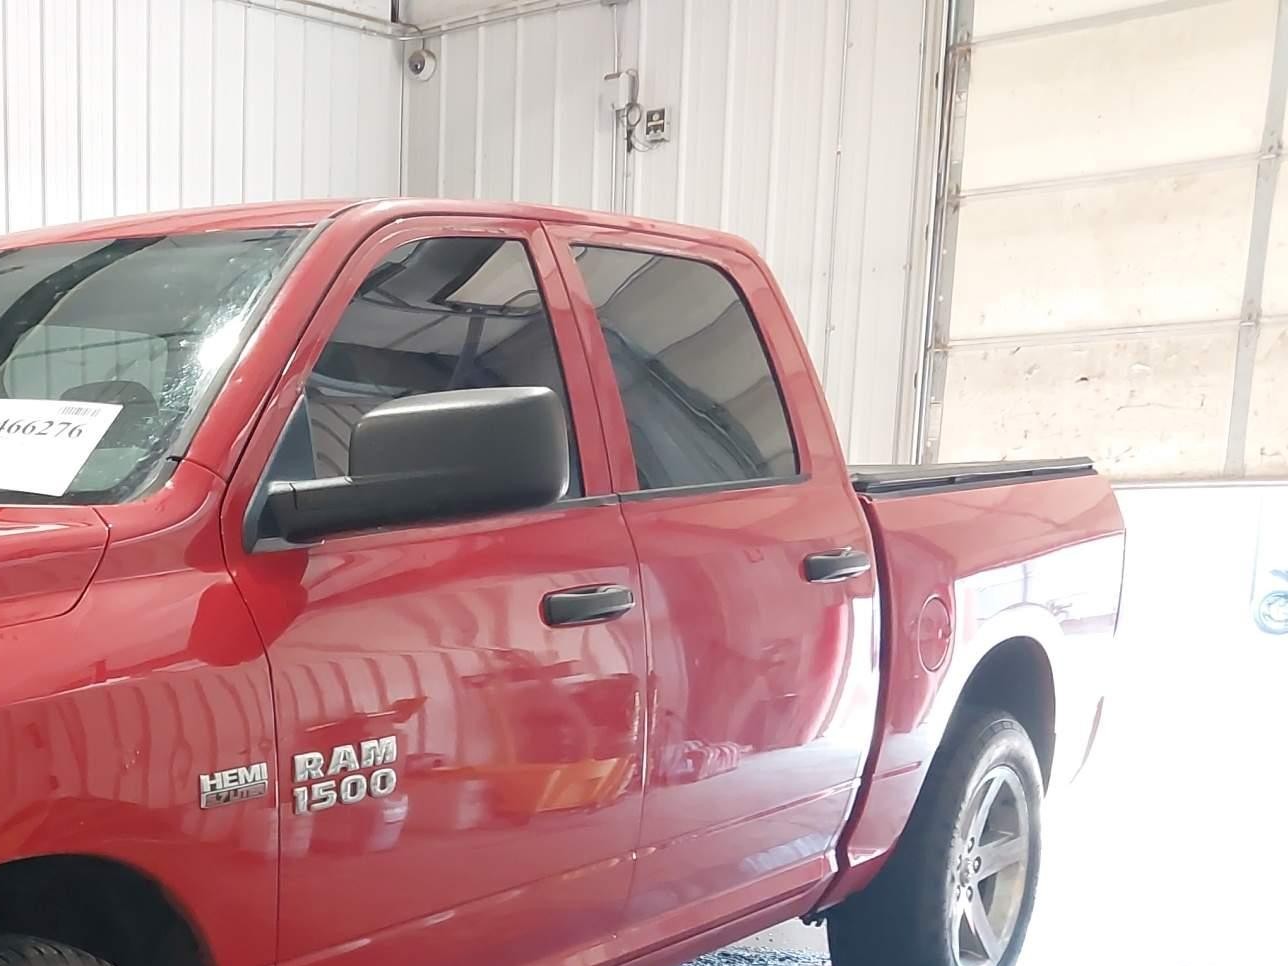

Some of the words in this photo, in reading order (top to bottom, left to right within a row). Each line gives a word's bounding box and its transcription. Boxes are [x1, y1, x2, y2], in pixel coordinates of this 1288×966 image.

[199, 761, 269, 793] HEMI
[292, 735, 398, 783] RAM
[292, 767, 398, 816] 1500
